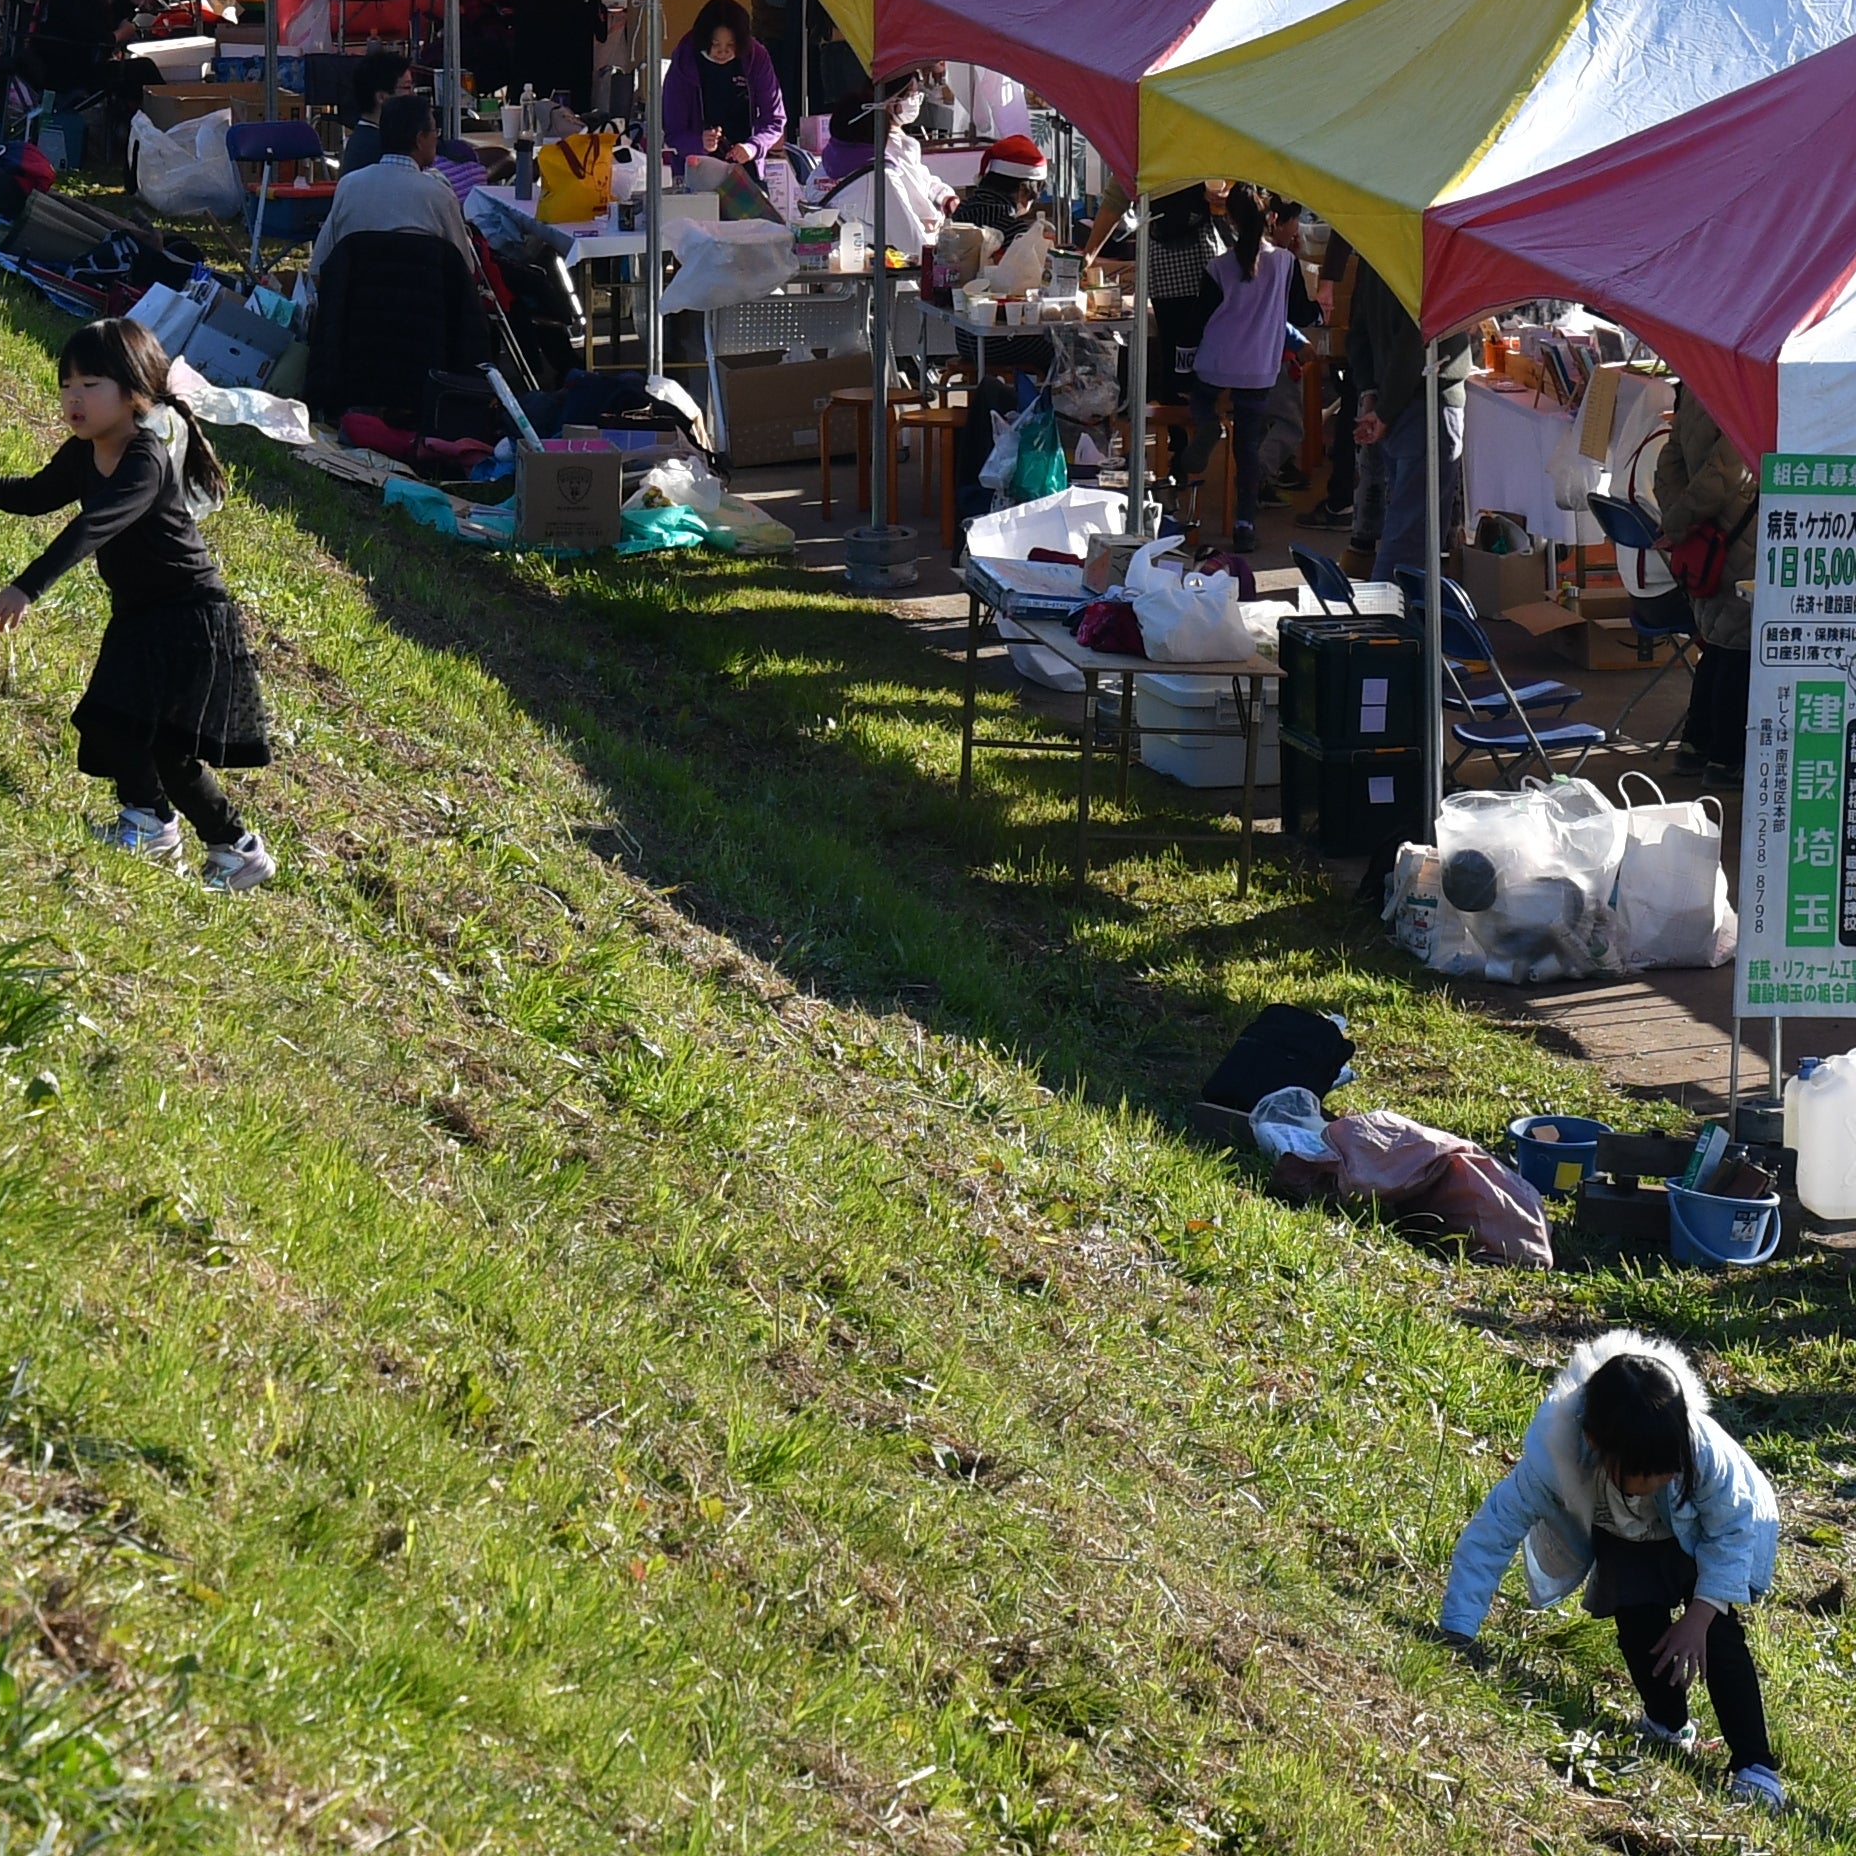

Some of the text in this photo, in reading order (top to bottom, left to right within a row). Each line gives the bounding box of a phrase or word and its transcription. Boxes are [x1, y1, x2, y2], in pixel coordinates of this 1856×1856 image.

[1765, 646, 1846, 661] 口座引落です
[1772, 685, 1790, 833] 詳しくは 南武地区本部
[1793, 693, 1843, 933] 建設埼玉
